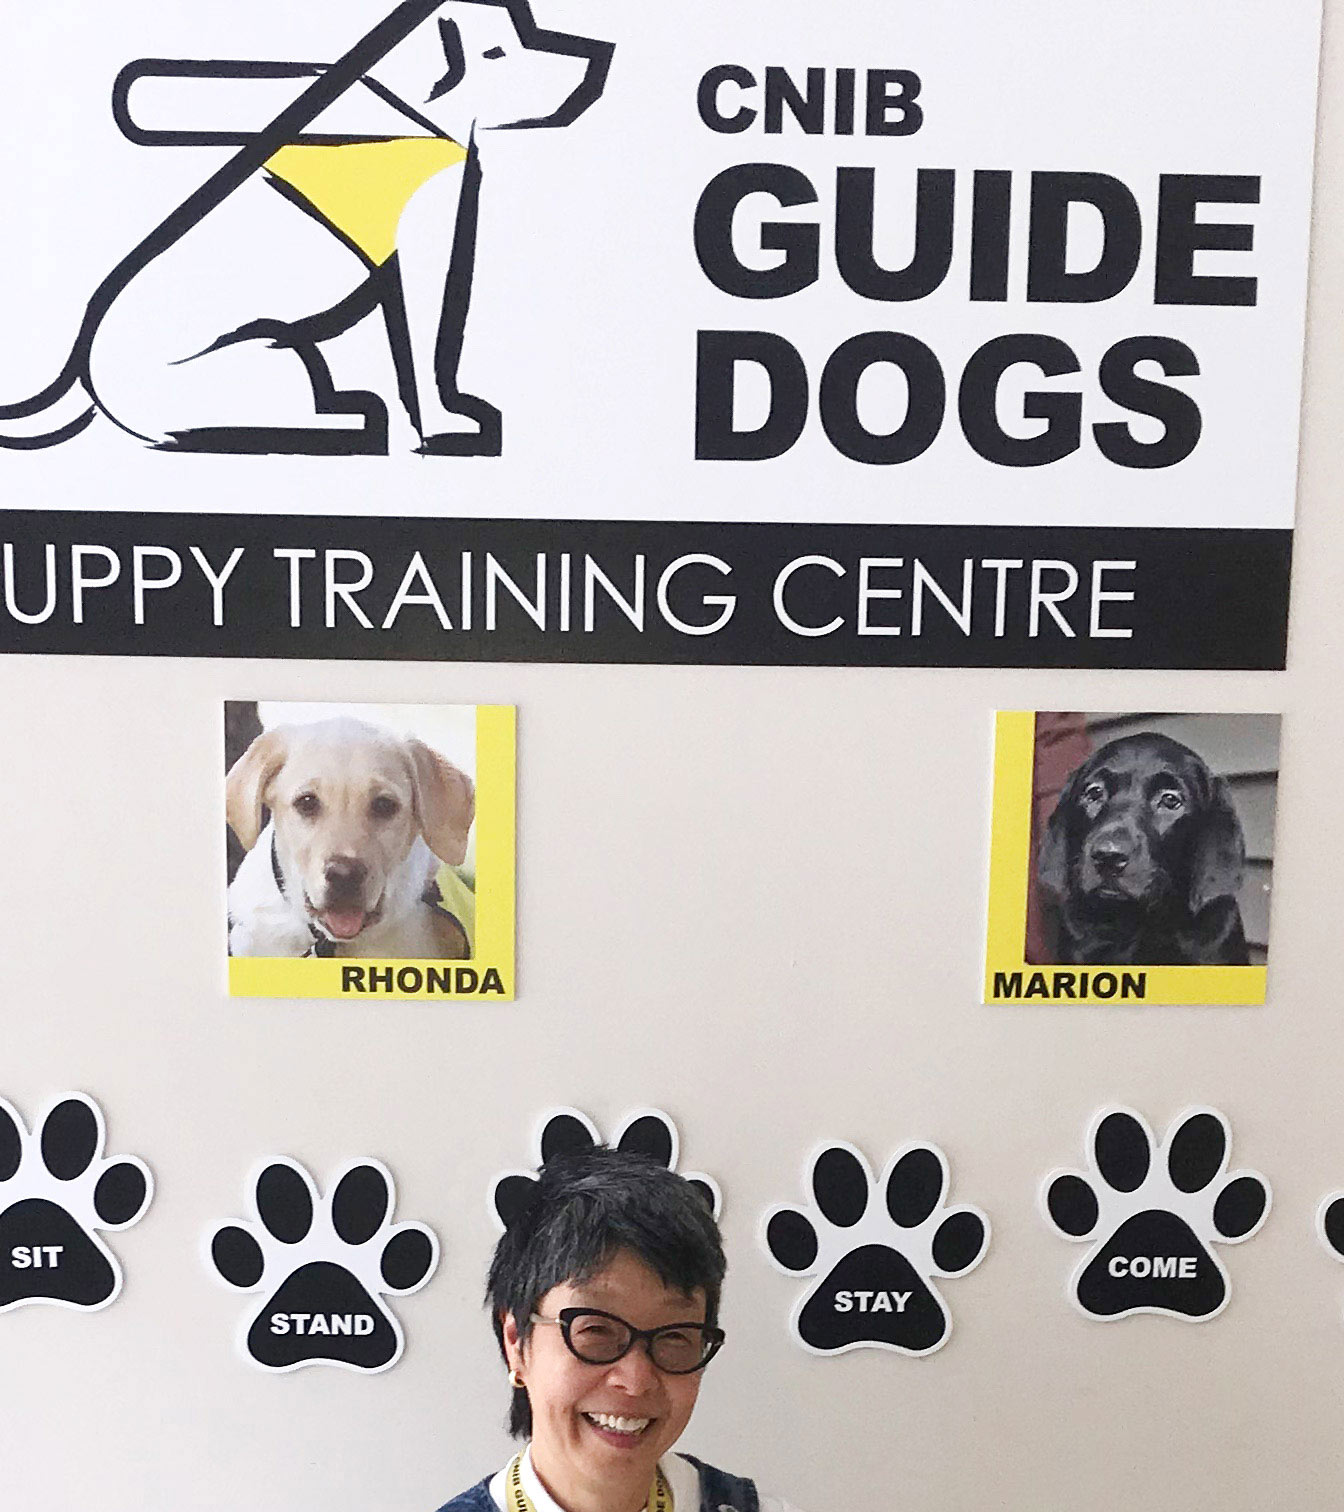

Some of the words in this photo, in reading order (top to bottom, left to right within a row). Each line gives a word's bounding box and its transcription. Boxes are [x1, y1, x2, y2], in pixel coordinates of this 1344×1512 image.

[696, 64, 924, 137] CNIB
[693, 162, 1262, 307] GUIDE
[694, 329, 1203, 470] DOGS
[273, 548, 737, 636] TRAINING
[772, 554, 1137, 638] CENTRE
[341, 965, 506, 995] RHONDA
[992, 972, 1147, 999] MARION
[11, 1245, 64, 1269] SIT
[1108, 1256, 1198, 1279] COME
[833, 1290, 913, 1313] STAY
[270, 1312, 375, 1336] STAND
